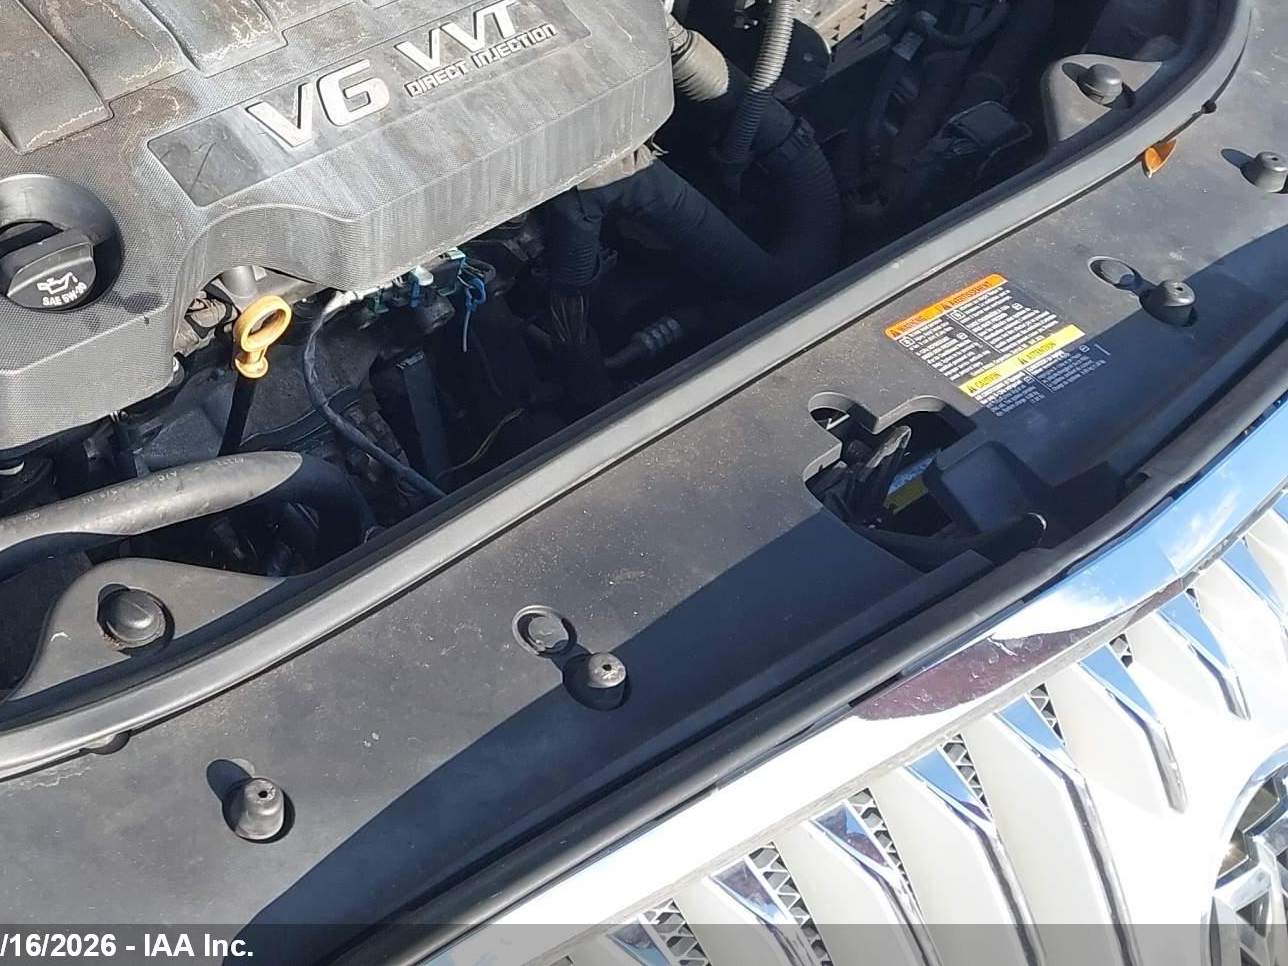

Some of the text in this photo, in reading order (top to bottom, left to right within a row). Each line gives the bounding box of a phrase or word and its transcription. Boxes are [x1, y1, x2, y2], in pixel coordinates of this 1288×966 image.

[404, 23, 557, 98] DIRECT INJECTION
[244, 58, 390, 148] V6
[42, 295, 62, 307] SAE
